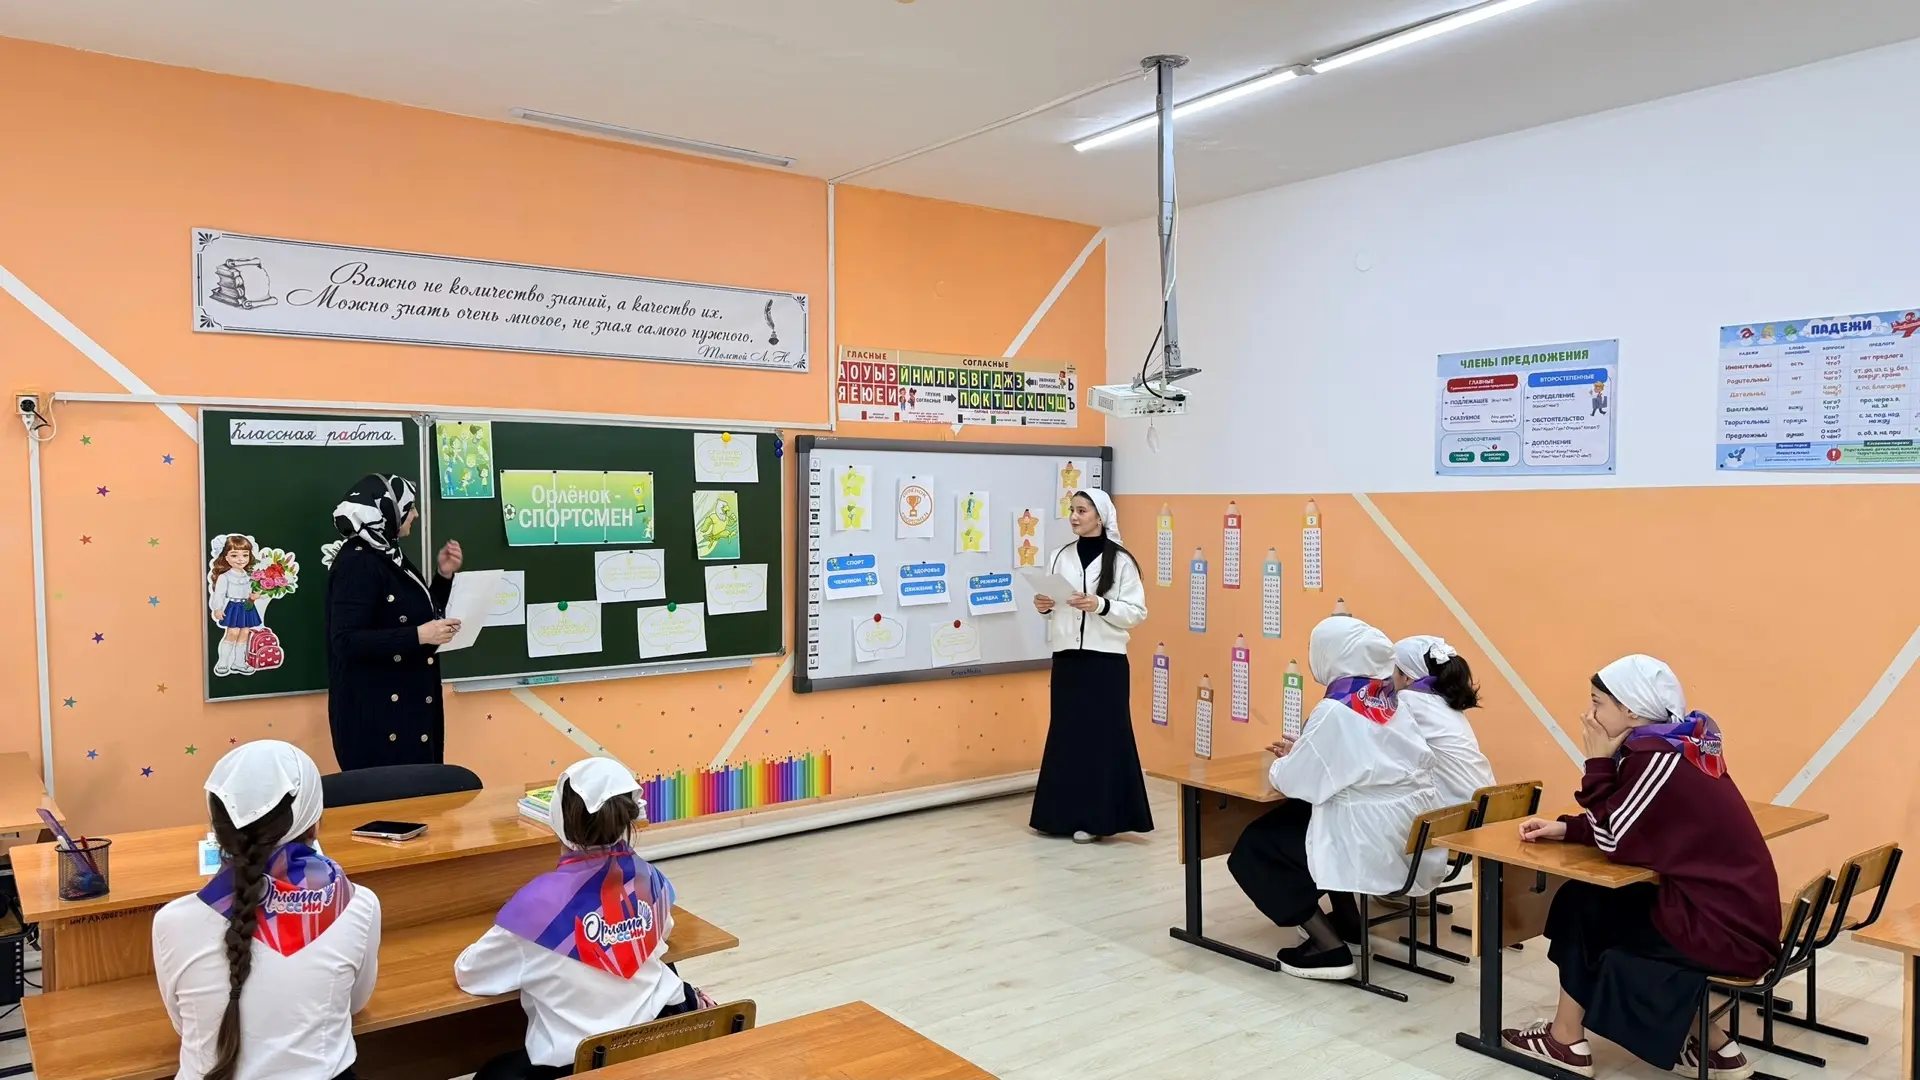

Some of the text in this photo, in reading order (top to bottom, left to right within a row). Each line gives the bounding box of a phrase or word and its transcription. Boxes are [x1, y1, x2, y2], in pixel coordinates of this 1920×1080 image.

[329, 261, 723, 320] Важно не количество знаний, а качество их.
[286, 284, 753, 345] Можно знать очень многое, не зная самого нужного.
[1811, 320, 1872, 335] ПАДЕЖИ
[698, 344, 791, 364] Толстой Л. Н.
[847, 350, 887, 360] ГЛАСНЫЕ
[1460, 349, 1589, 369] ЧЛЕНЫ ПРЕДЛОЖЕНИЯ
[1873, 353, 1903, 361] предлога
[963, 359, 1009, 368] СОГЛАСНЫЕ
[1725, 362, 1772, 370] Именительный
[1540, 374, 1594, 382] ВТОРОСТЕПЕННЫЕ
[1727, 376, 1769, 384] Родительный
[1724, 418, 1770, 426] Творительный
[231, 421, 397, 446] Классная работа.
[1726, 432, 1767, 440] Предложный
[532, 484, 611, 506] Орлёнок
[519, 507, 633, 529] СПОРТСМЕН
[904, 585, 933, 593] ДВИЖЕНИЕ
[268, 903, 322, 912] РОССИИ
[585, 914, 644, 943] Орлята
[604, 929, 645, 944] РОССИИ
